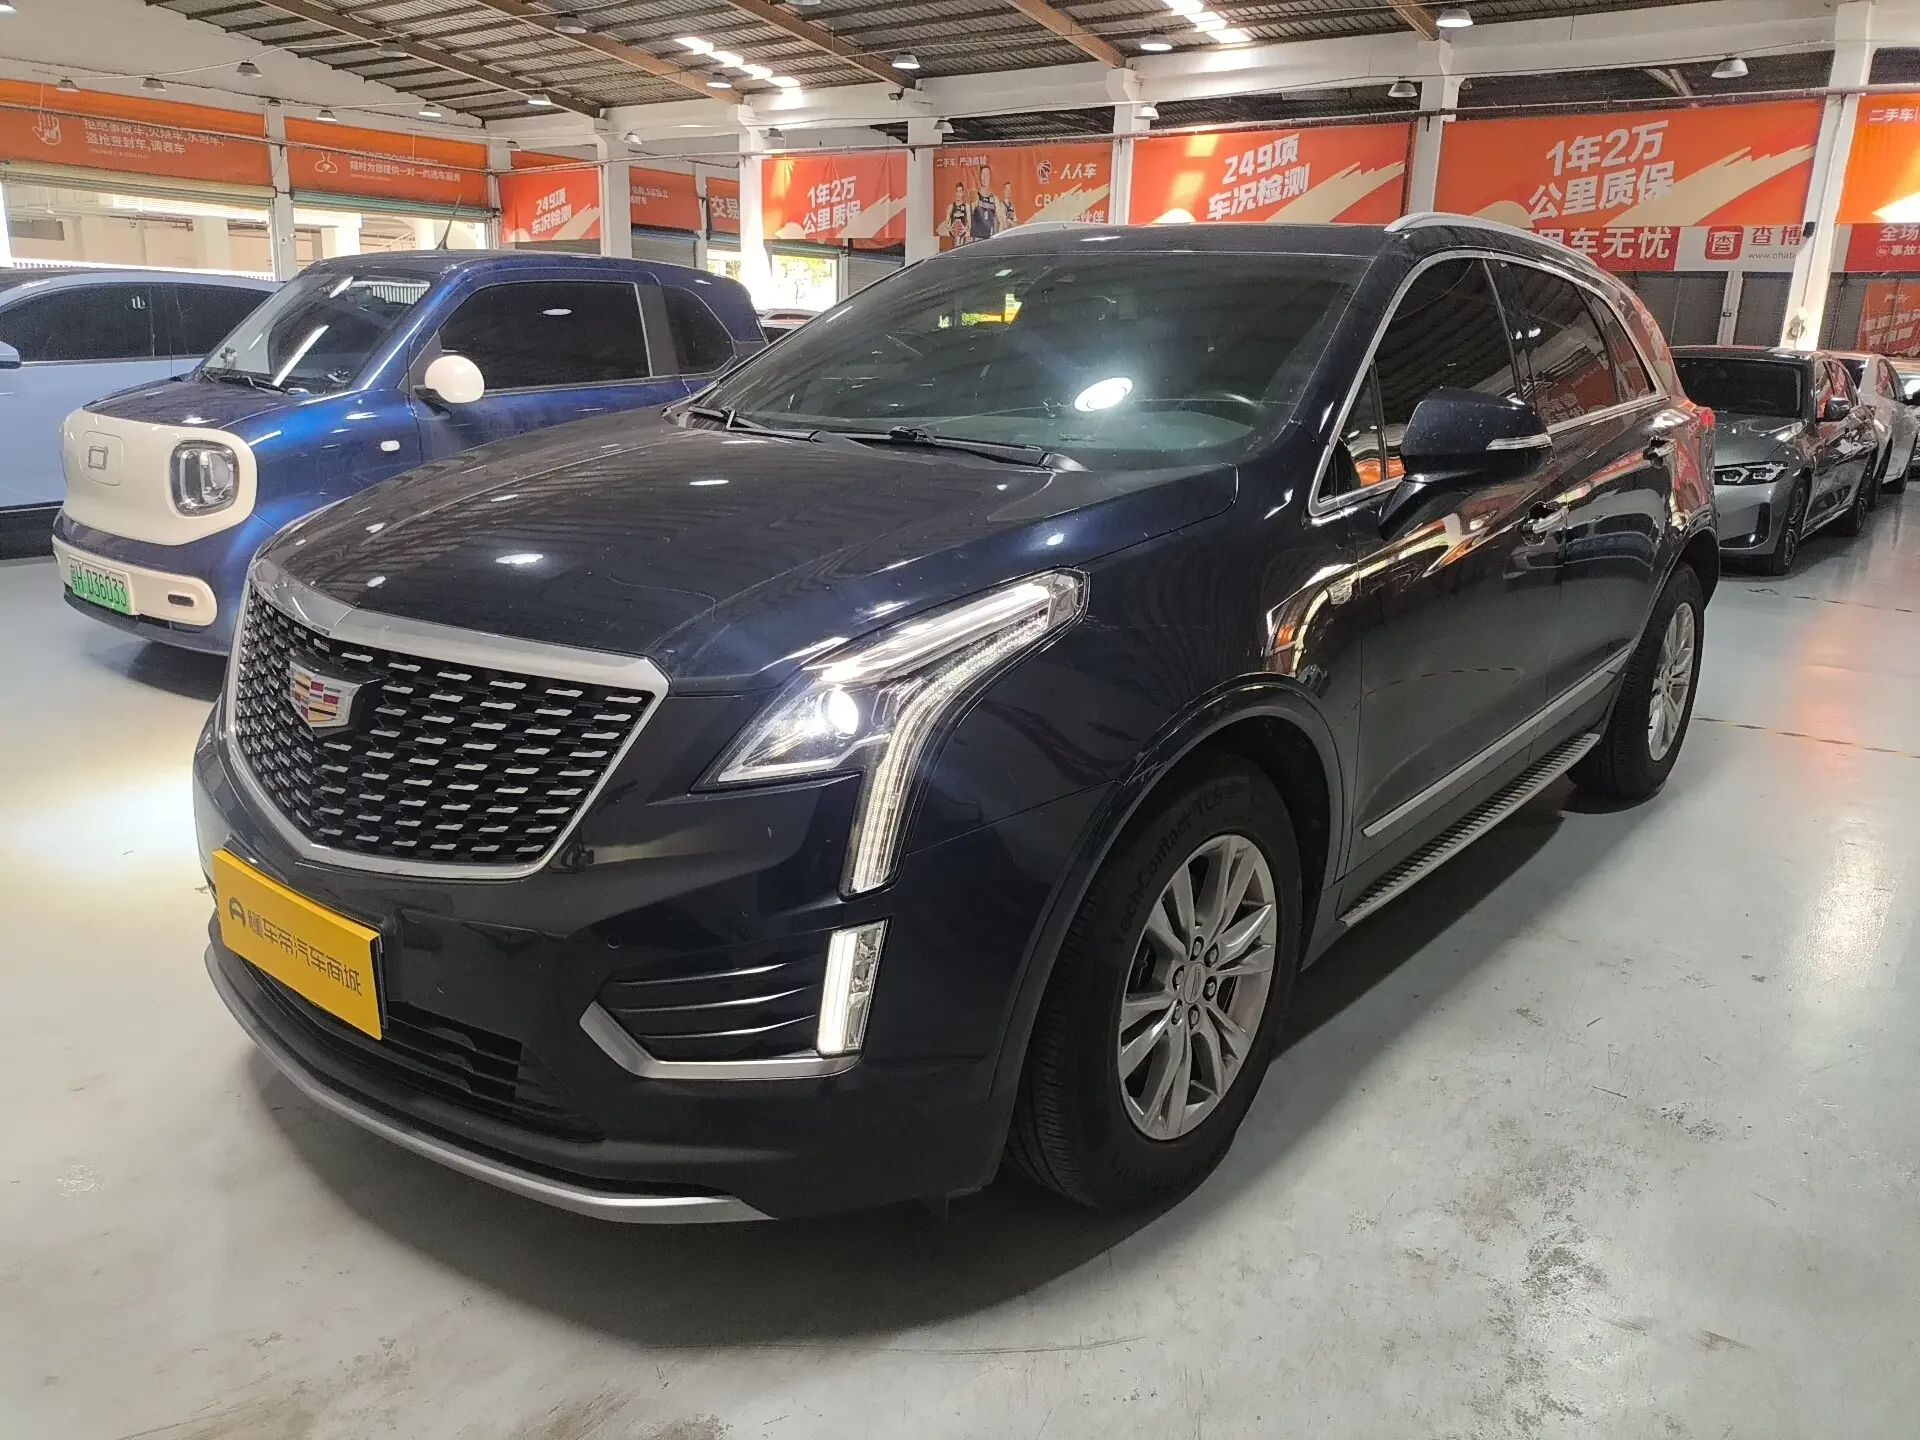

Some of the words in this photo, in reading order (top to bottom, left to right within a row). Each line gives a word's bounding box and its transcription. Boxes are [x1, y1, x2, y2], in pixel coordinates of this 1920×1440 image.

[1222, 132, 1300, 185] 249项
[1546, 120, 1669, 177] 1年2万
[536, 187, 565, 216] 249项
[807, 176, 857, 208] 1年2万
[1206, 164, 1311, 221] 车况检测
[1529, 160, 1675, 220] 公里质保
[532, 204, 572, 235] 车况检测
[803, 200, 861, 234] 公里质保
[1890, 244, 1920, 256] 事故
[248, 908, 363, 997] 懂车帝汽车商城
